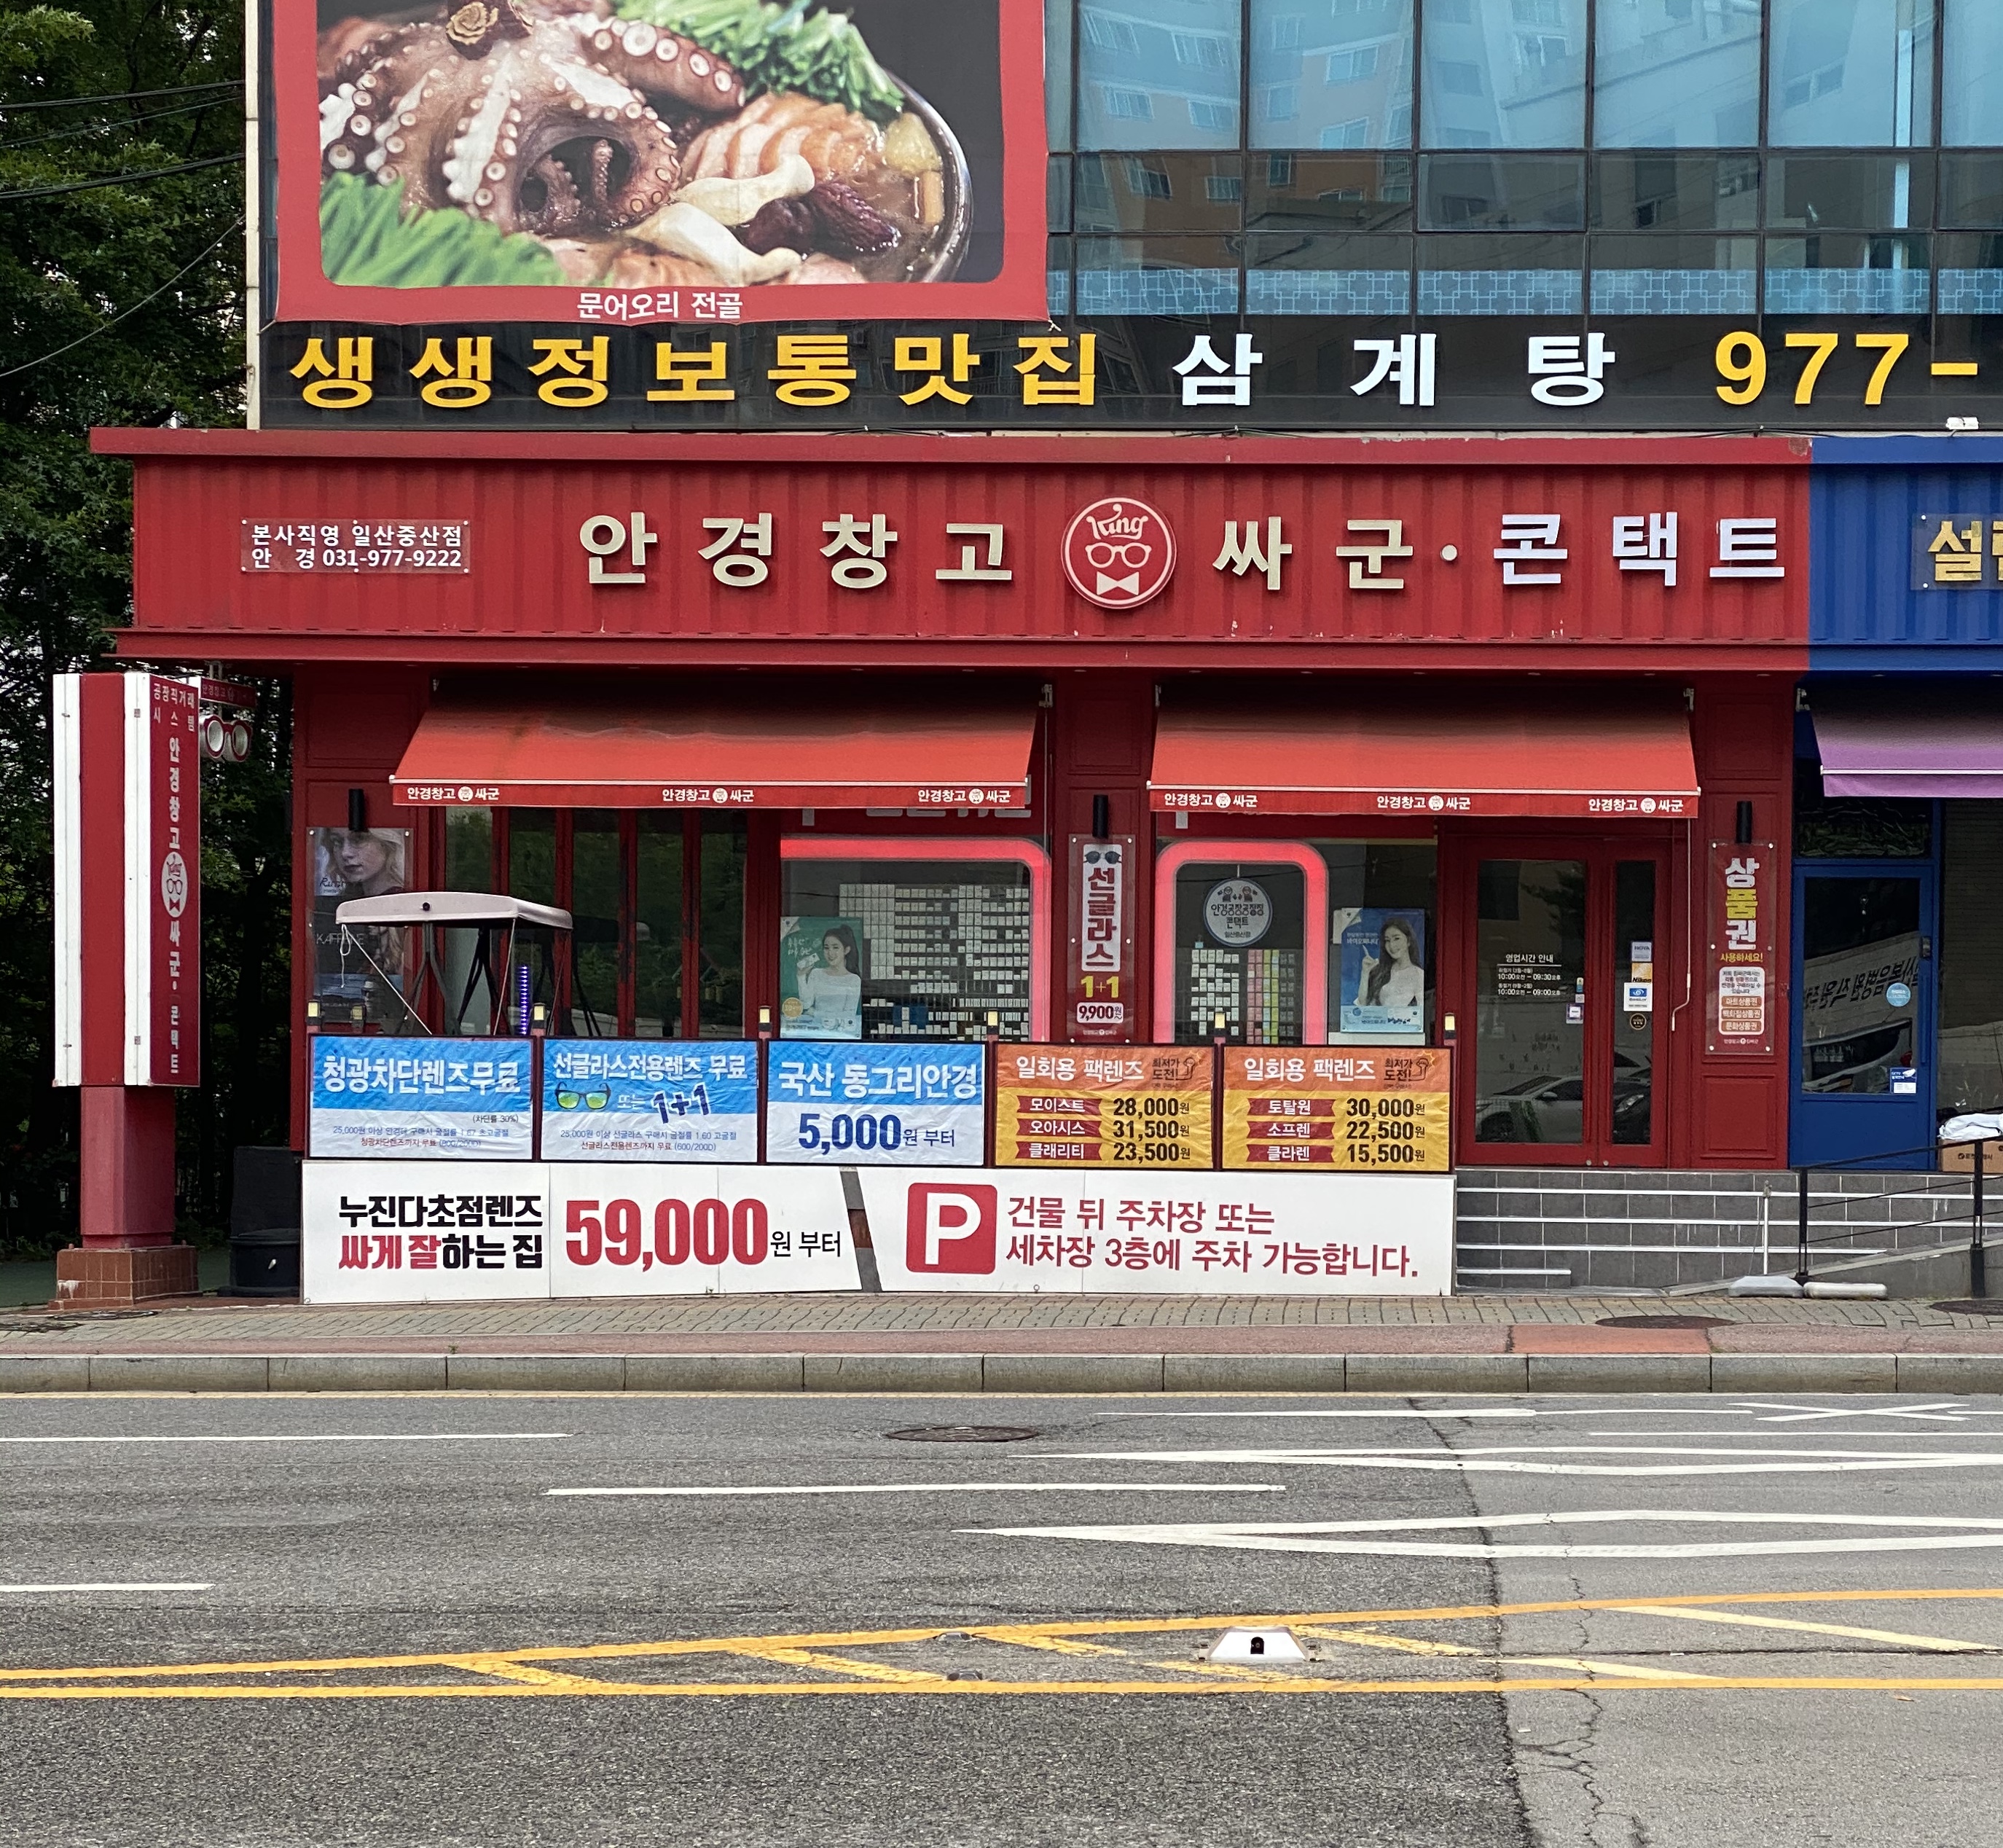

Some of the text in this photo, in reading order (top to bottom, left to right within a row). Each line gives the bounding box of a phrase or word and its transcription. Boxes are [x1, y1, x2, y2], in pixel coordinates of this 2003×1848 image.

[577, 291, 743, 321] 문어오리 전골
[1086, 504, 1149, 539] King
[251, 524, 462, 547] 본사직영 일산중산점
[322, 549, 462, 568] 031-977-9222
[580, 512, 1012, 589] 안경창고
[1927, 520, 2003, 581] 설
[154, 683, 195, 708] 공장직거래
[153, 707, 195, 732] 시스템
[169, 737, 180, 850] 안경창고
[407, 787, 499, 800] 안경창고 싸군
[662, 788, 754, 802] 안경창고 싸군
[918, 788, 1011, 803] 안경창고 싸군
[1164, 793, 1258, 807] 안경창고 싸군
[1377, 796, 1471, 810] 안경창고 싸군
[1588, 799, 1684, 813] 안경창고 싸군
[1725, 858, 1760, 950] 상품권
[1085, 868, 1117, 966] 선글라스
[1505, 954, 1553, 964] 영업시간 안내
[1720, 952, 1763, 963] 사용하세요!
[1081, 975, 1119, 998] 1+1
[554, 1052, 748, 1081] 선글라스전용렌즈 무료
[1016, 1056, 1180, 1083] 일회용 팩렌즈 최저가
[1153, 1068, 1179, 1081] 도전!
[1244, 1057, 1413, 1082] 일회용 팩렌즈 최저가
[1384, 1068, 1412, 1081] 도전!
[778, 1062, 977, 1099] 국산 동그리안경
[617, 1082, 712, 1124] 또는 1+1
[1030, 1097, 1190, 1119] 모이스트 28,000원
[1268, 1098, 1425, 1119] 토탈원 30,000원
[333, 1126, 365, 1135] 25,000원
[368, 1126, 383, 1135] 이상
[472, 1115, 519, 1124] (차단률 30%)
[1029, 1120, 1190, 1142] 오아시스 31,500원
[422, 1138, 437, 1147] 무료
[560, 1129, 593, 1139] 25,000원
[596, 1129, 611, 1139] 이상
[613, 1130, 643, 1139] 선글라스
[646, 1130, 668, 1140] 구매시
[696, 1131, 712, 1140] 1.60
[799, 1113, 955, 1155] 5,000원 부터
[1267, 1121, 1425, 1142] 소프렌 22,500원
[581, 1141, 655, 1151] 선글라스전용렌즈까지
[657, 1142, 672, 1151] 무료
[1029, 1143, 1191, 1164] 클래리티 23,500원
[1267, 1143, 1425, 1166] 클라렌 15,500원
[339, 1194, 543, 1227] 누진다초점렌즈
[1008, 1196, 1274, 1235] 건물 뒤 주차장 또는
[566, 1198, 842, 1272] 59,000원 부터
[925, 1192, 981, 1265] P
[339, 1234, 543, 1269] 싸게 잘하는 집
[1006, 1234, 1418, 1277] 세차장 3층에 주차 가능합니다.
